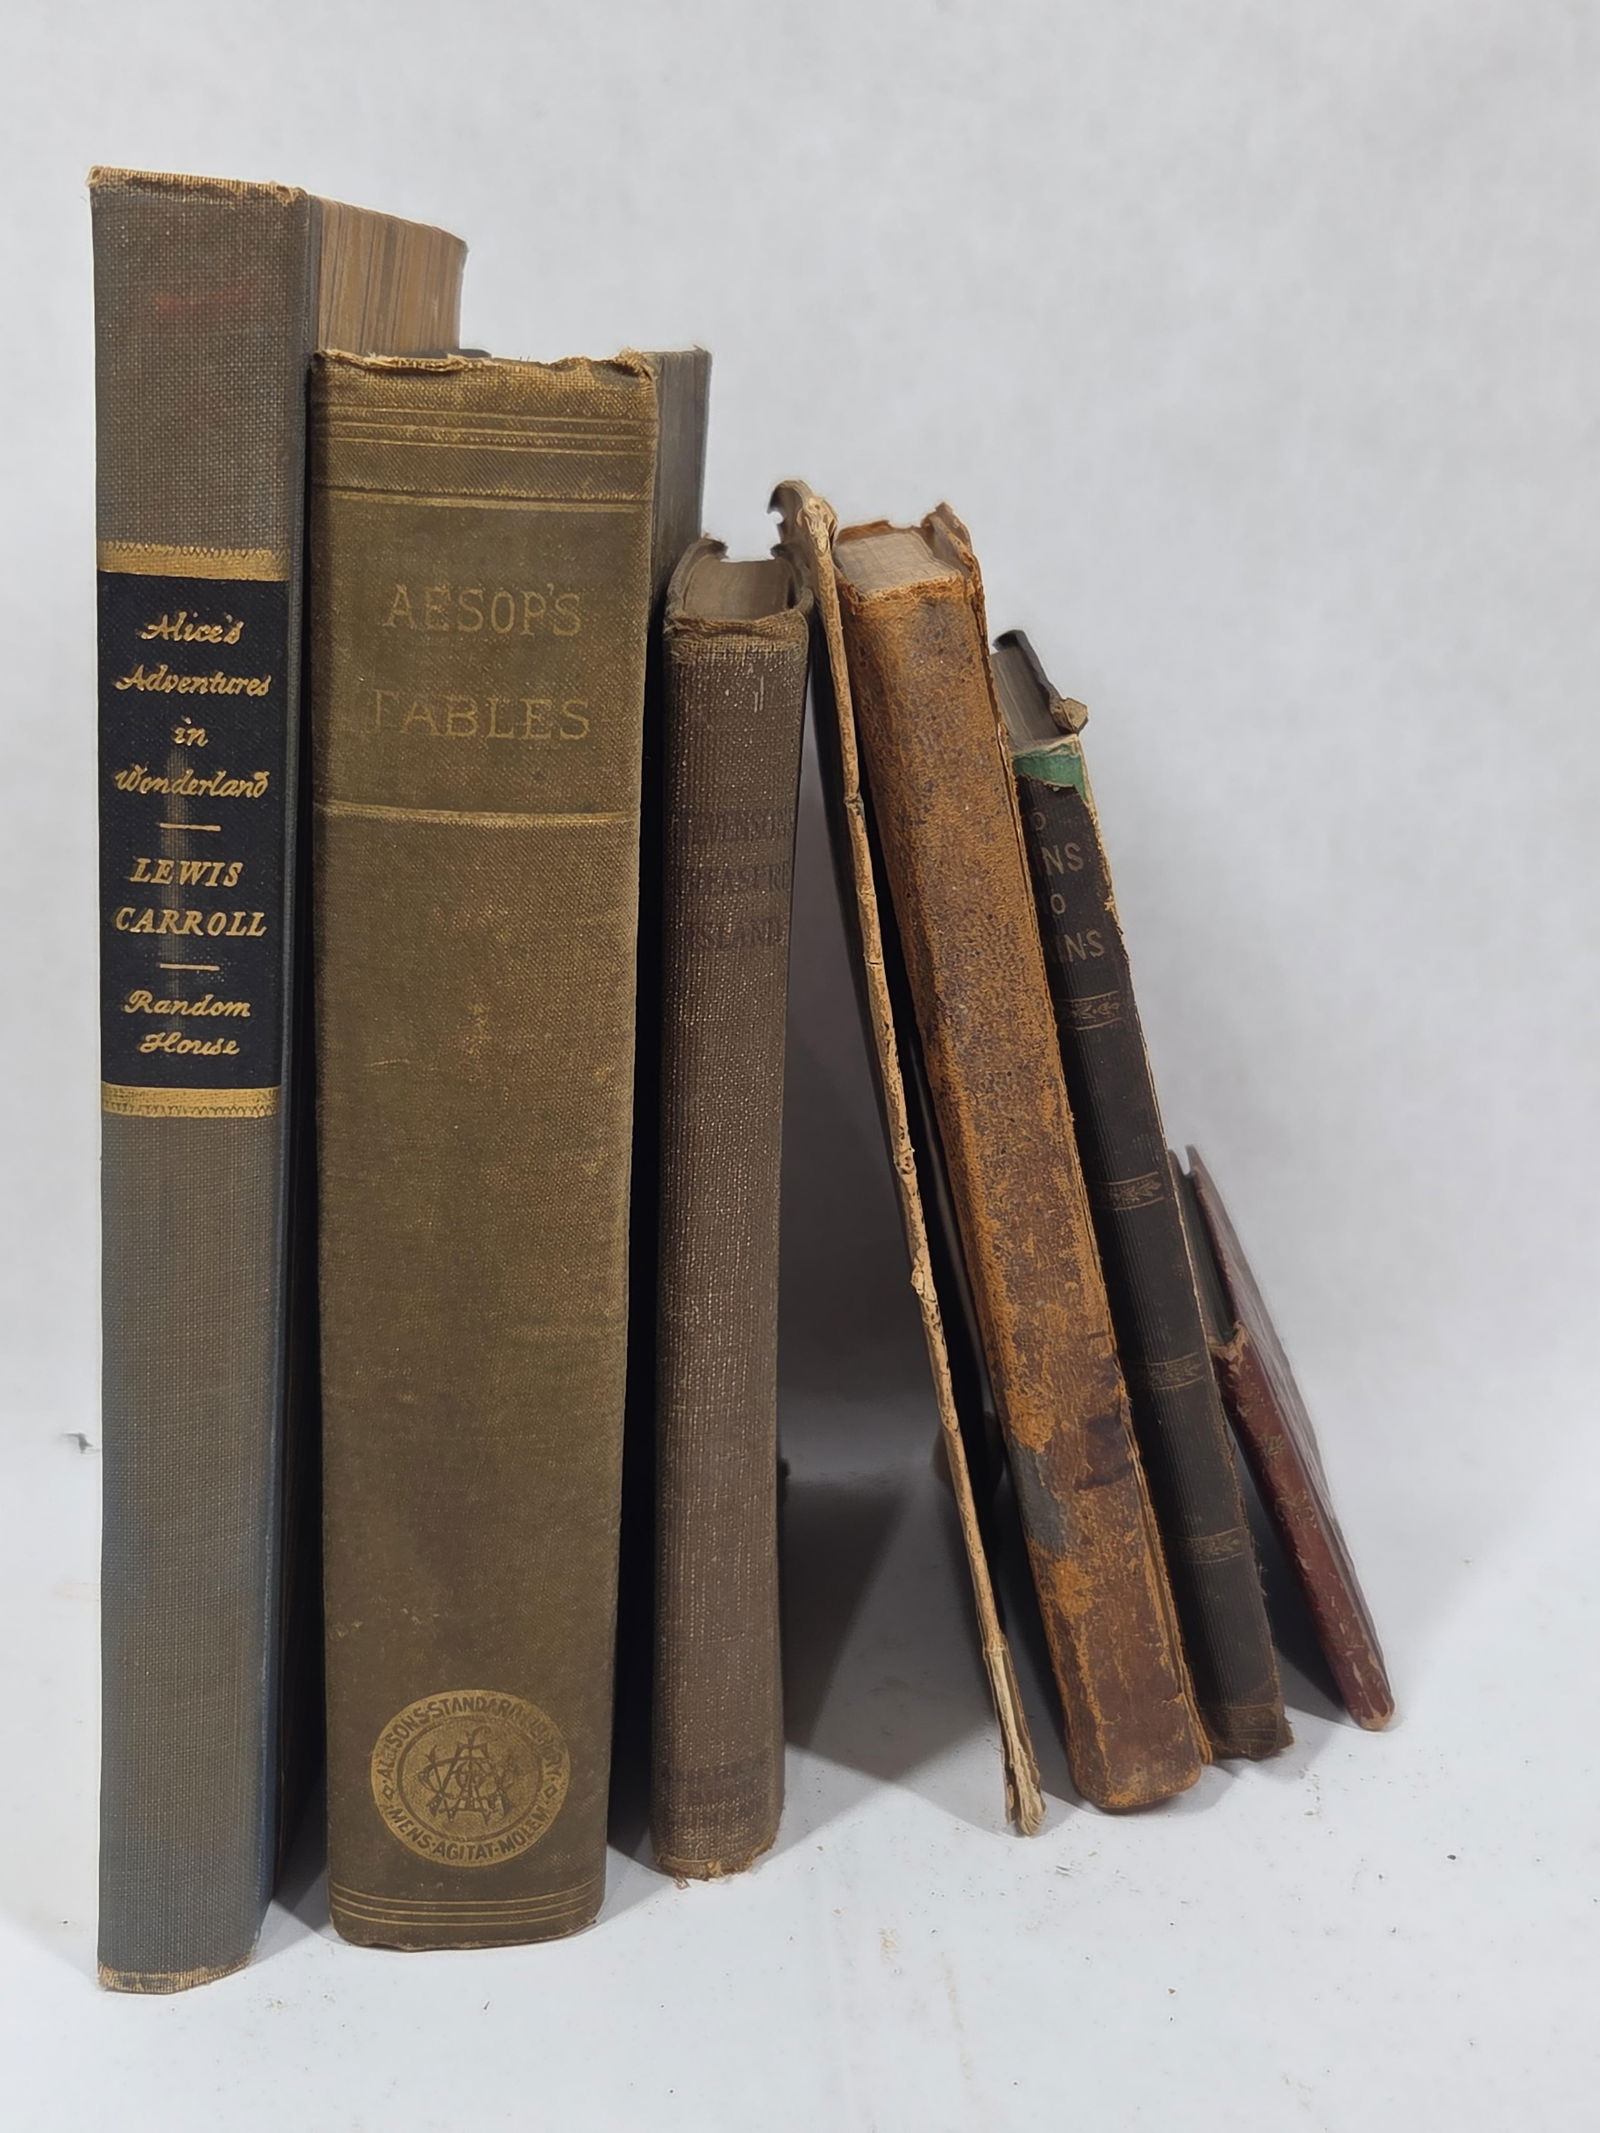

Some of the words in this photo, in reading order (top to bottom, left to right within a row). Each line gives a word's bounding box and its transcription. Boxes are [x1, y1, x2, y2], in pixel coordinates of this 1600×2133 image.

[381, 582, 582, 638] AESOP'S
[140, 610, 245, 646] Alice's
[113, 663, 272, 697] Adventures
[171, 715, 210, 747] in
[363, 688, 591, 741] FABLES
[114, 763, 271, 799] Wonderland
[128, 856, 245, 888] LEWIS
[114, 906, 268, 938] CARROLL
[120, 989, 252, 1018] Random
[138, 1031, 241, 1056] House
[386, 1807, 433, 1850] MENS
[431, 1840, 495, 1861] AGITAT
